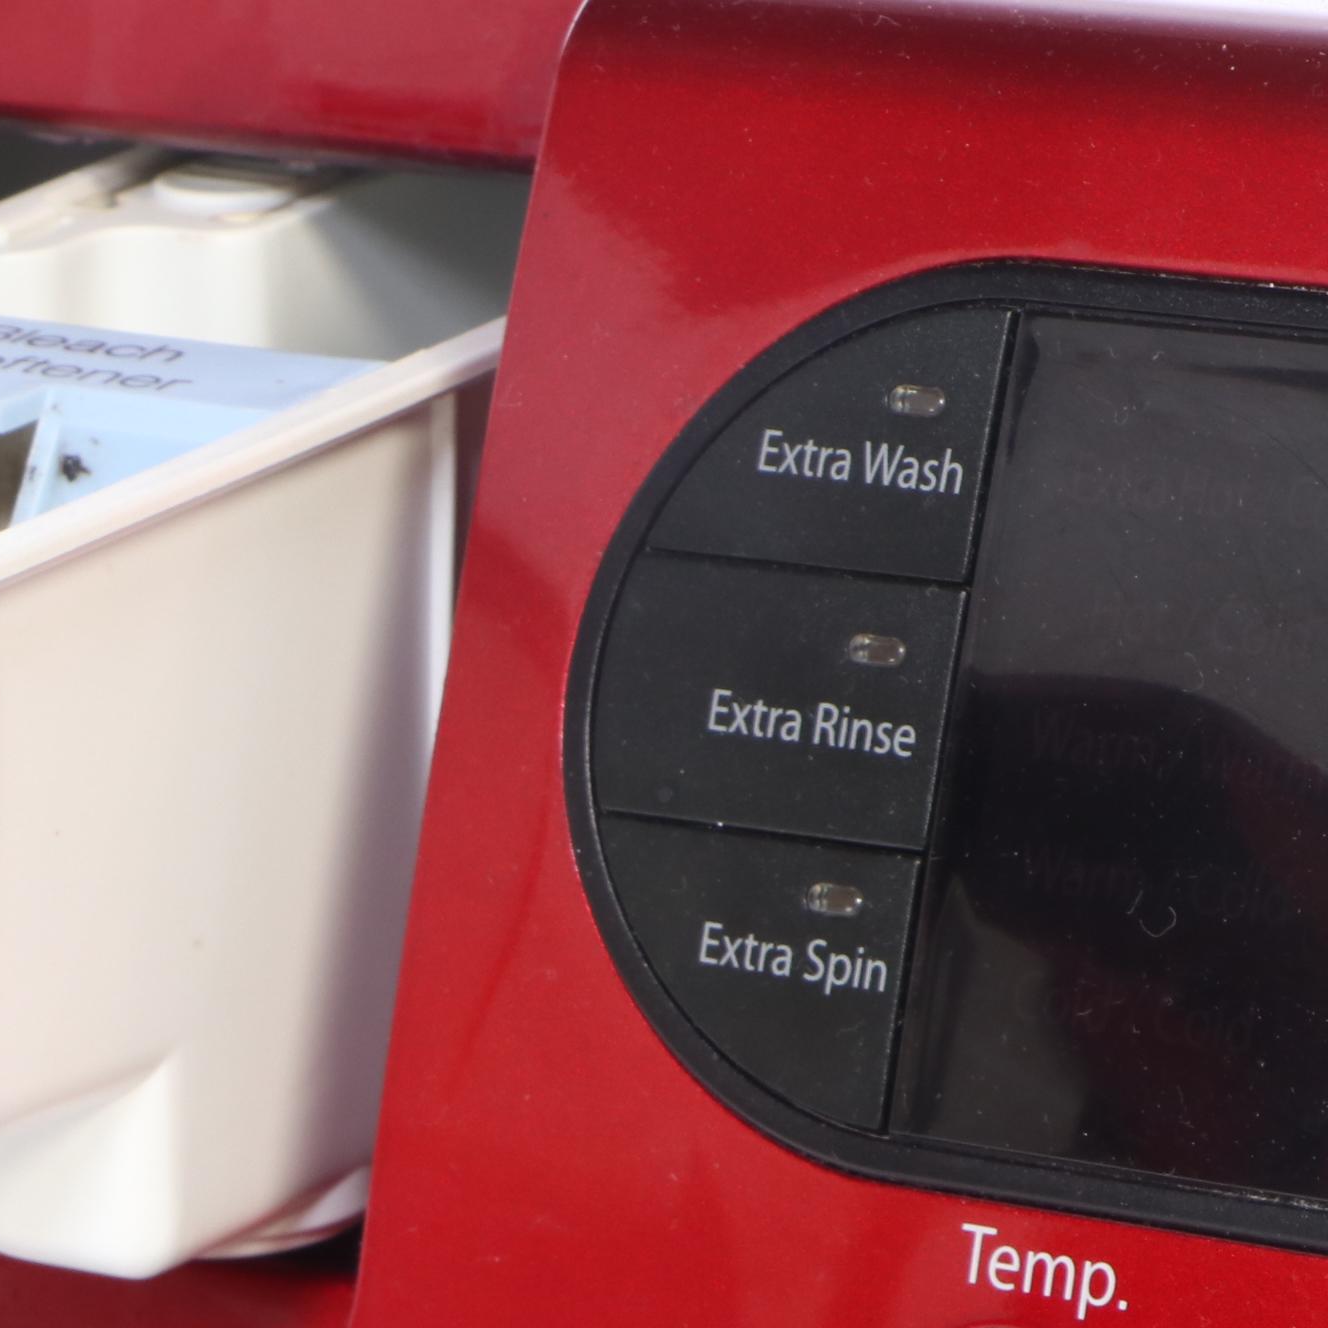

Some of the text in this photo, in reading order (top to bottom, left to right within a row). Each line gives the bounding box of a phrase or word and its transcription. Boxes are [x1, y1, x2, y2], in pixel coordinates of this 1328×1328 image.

[755, 427, 965, 496] Extra Wash
[706, 687, 918, 759] Extra Rinse
[698, 920, 889, 996] Extra Spin
[960, 1221, 1129, 1322] Temp.
